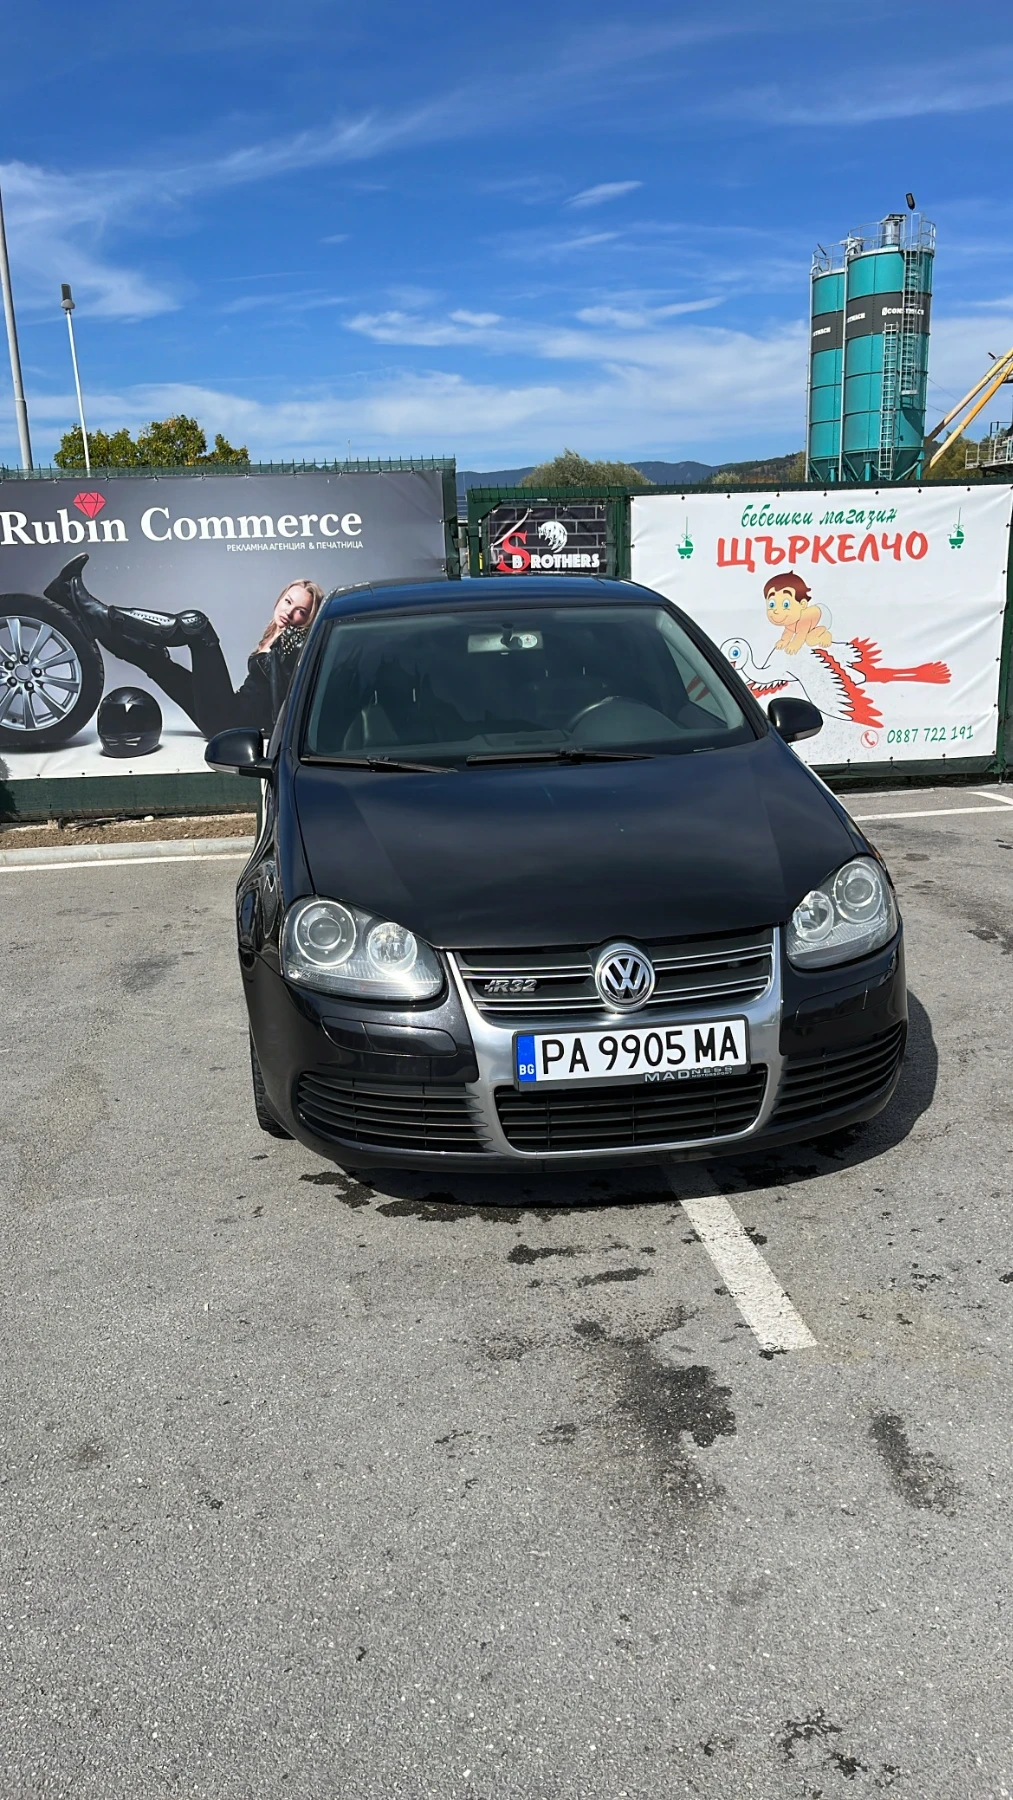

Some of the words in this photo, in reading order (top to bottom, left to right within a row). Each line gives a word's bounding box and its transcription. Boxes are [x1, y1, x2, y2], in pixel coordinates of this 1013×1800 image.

[0, 507, 129, 545] Rubin
[140, 507, 363, 541] Commerce
[740, 504, 814, 528] бебешки
[819, 507, 898, 530] магазин
[226, 543, 269, 552] РЕКЛАМНА
[269, 542, 306, 551] АГЕНЦИЯ
[308, 542, 315, 550] &
[316, 540, 364, 550] ПЕЧАТНИЦА
[716, 530, 929, 573] ЩЪРКЕЛЧО
[886, 728, 919, 744] 0887
[924, 727, 947, 742] 722
[951, 725, 974, 740] 191
[541, 1038, 590, 1075] PA
[598, 1030, 686, 1071] 9905
[694, 1026, 739, 1063] MA
[519, 1063, 535, 1076] BG
[644, 1066, 733, 1082] MADNESS
